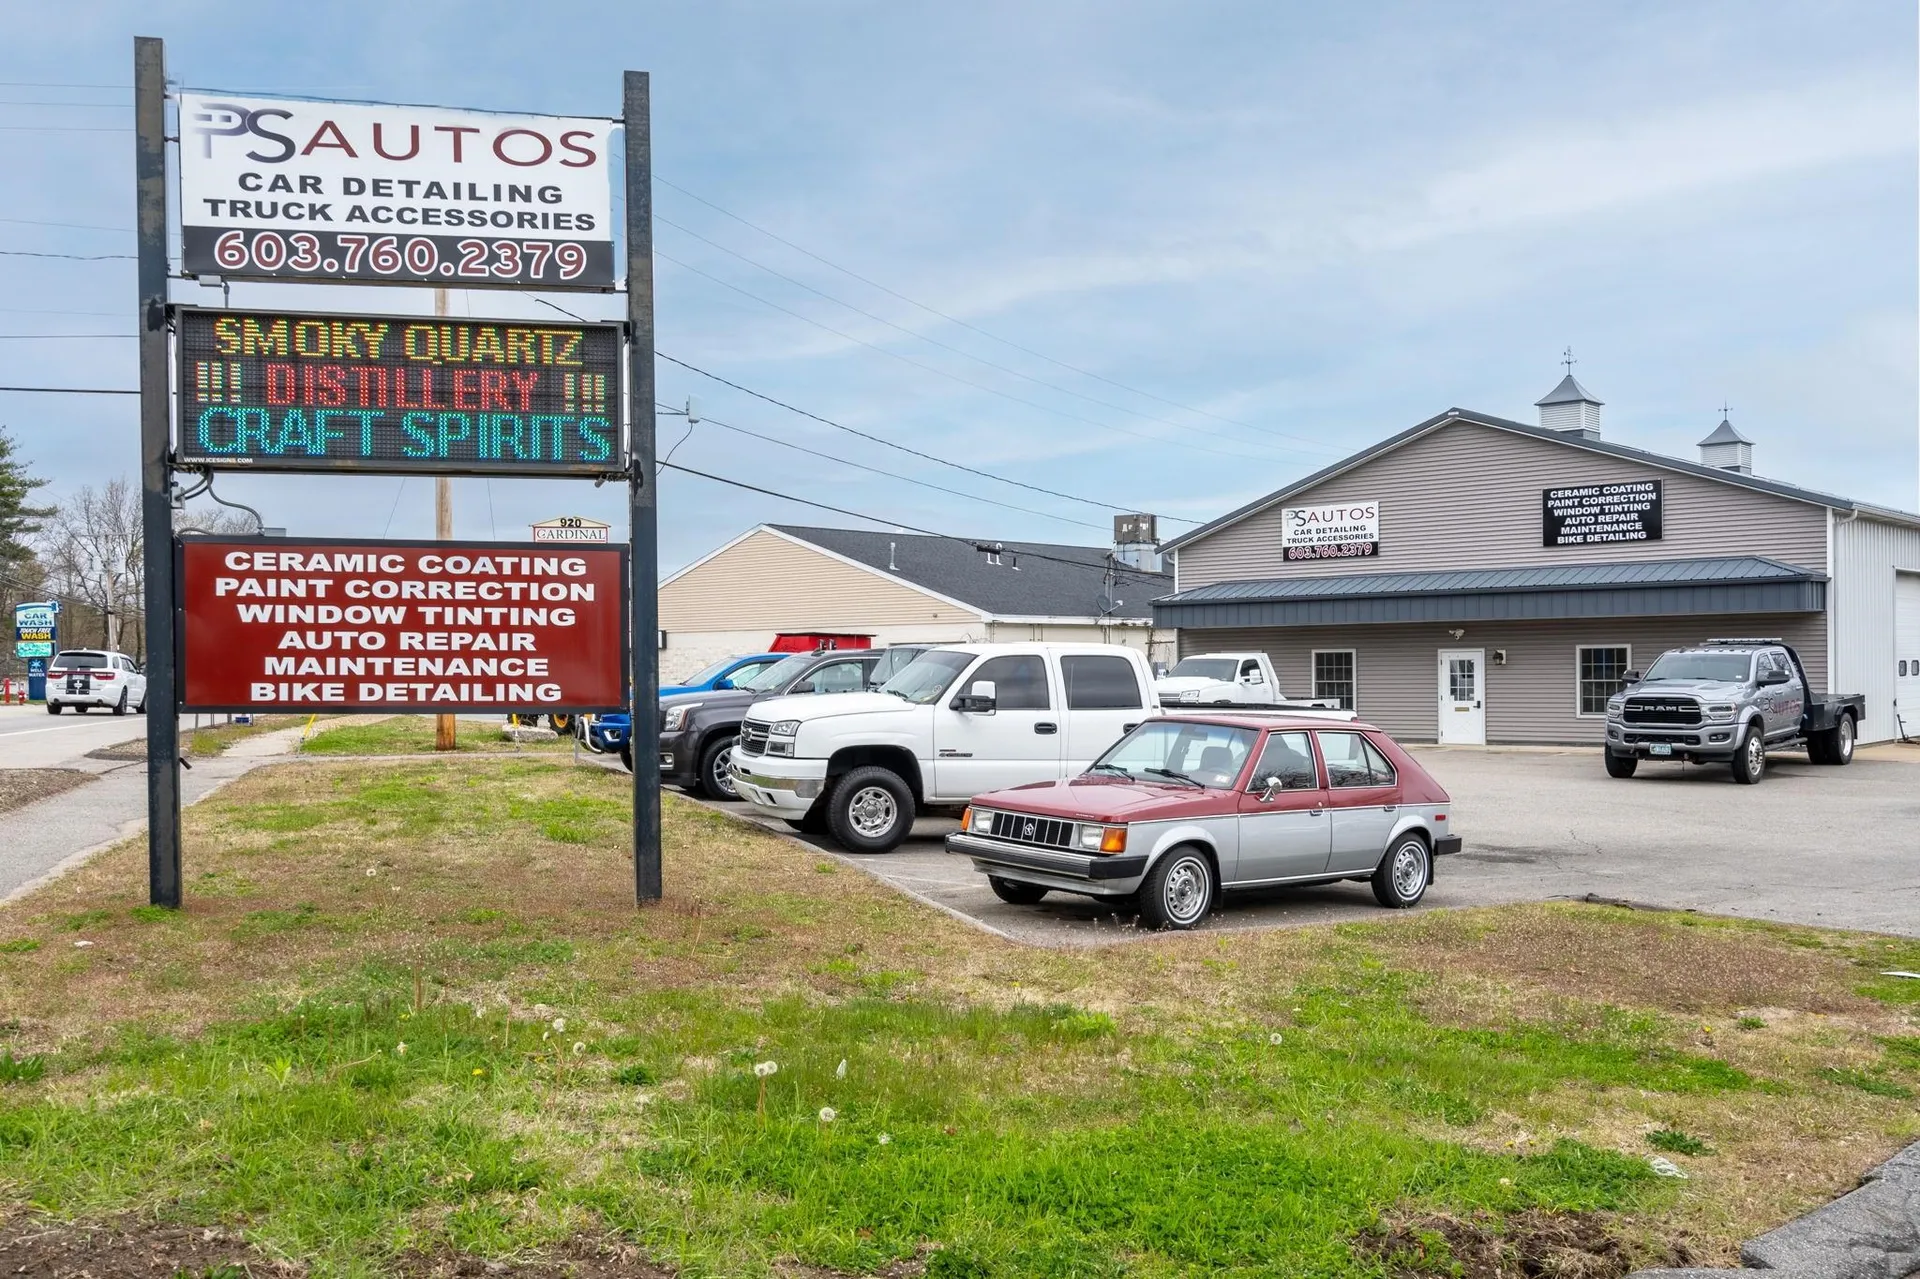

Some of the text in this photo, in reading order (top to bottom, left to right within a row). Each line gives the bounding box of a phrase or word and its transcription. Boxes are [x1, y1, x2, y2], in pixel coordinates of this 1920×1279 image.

[238, 172, 563, 204] CAR DETAILING
[203, 198, 596, 231] TRUCK ACCESSORIES
[213, 230, 587, 281] 603.760.2379
[214, 318, 584, 366] SMOKY QUARTZ
[196, 361, 606, 414] !!! DISTILLERY !!!
[199, 406, 612, 463] CRAFT SPIRITS
[1547, 492, 1656, 508] PAINT CORRECTION
[1550, 483, 1654, 498] CERAMIC COATING
[1553, 502, 1651, 516] WINDOW TINTING
[1564, 512, 1639, 525] AUTO REPAIR
[560, 517, 582, 528] 920
[1315, 524, 1367, 534] DETAILING
[1560, 522, 1643, 534] MAINTENANCE
[536, 529, 606, 540] CARDINAL
[1316, 533, 1374, 542] ACCESSORIES
[1557, 531, 1647, 544] BIKE DETAILING
[1288, 542, 1373, 560] 603.760.2379
[225, 551, 587, 576] CERAMIC COATING
[215, 578, 595, 602] PAINT CORRECTION
[24, 612, 47, 620] CAR
[237, 604, 576, 627] WINDOW TINTING
[278, 631, 537, 652] AUTO REPAIR
[264, 656, 549, 678] MAINTENANCE
[250, 682, 562, 703] BIKE DETAILING
